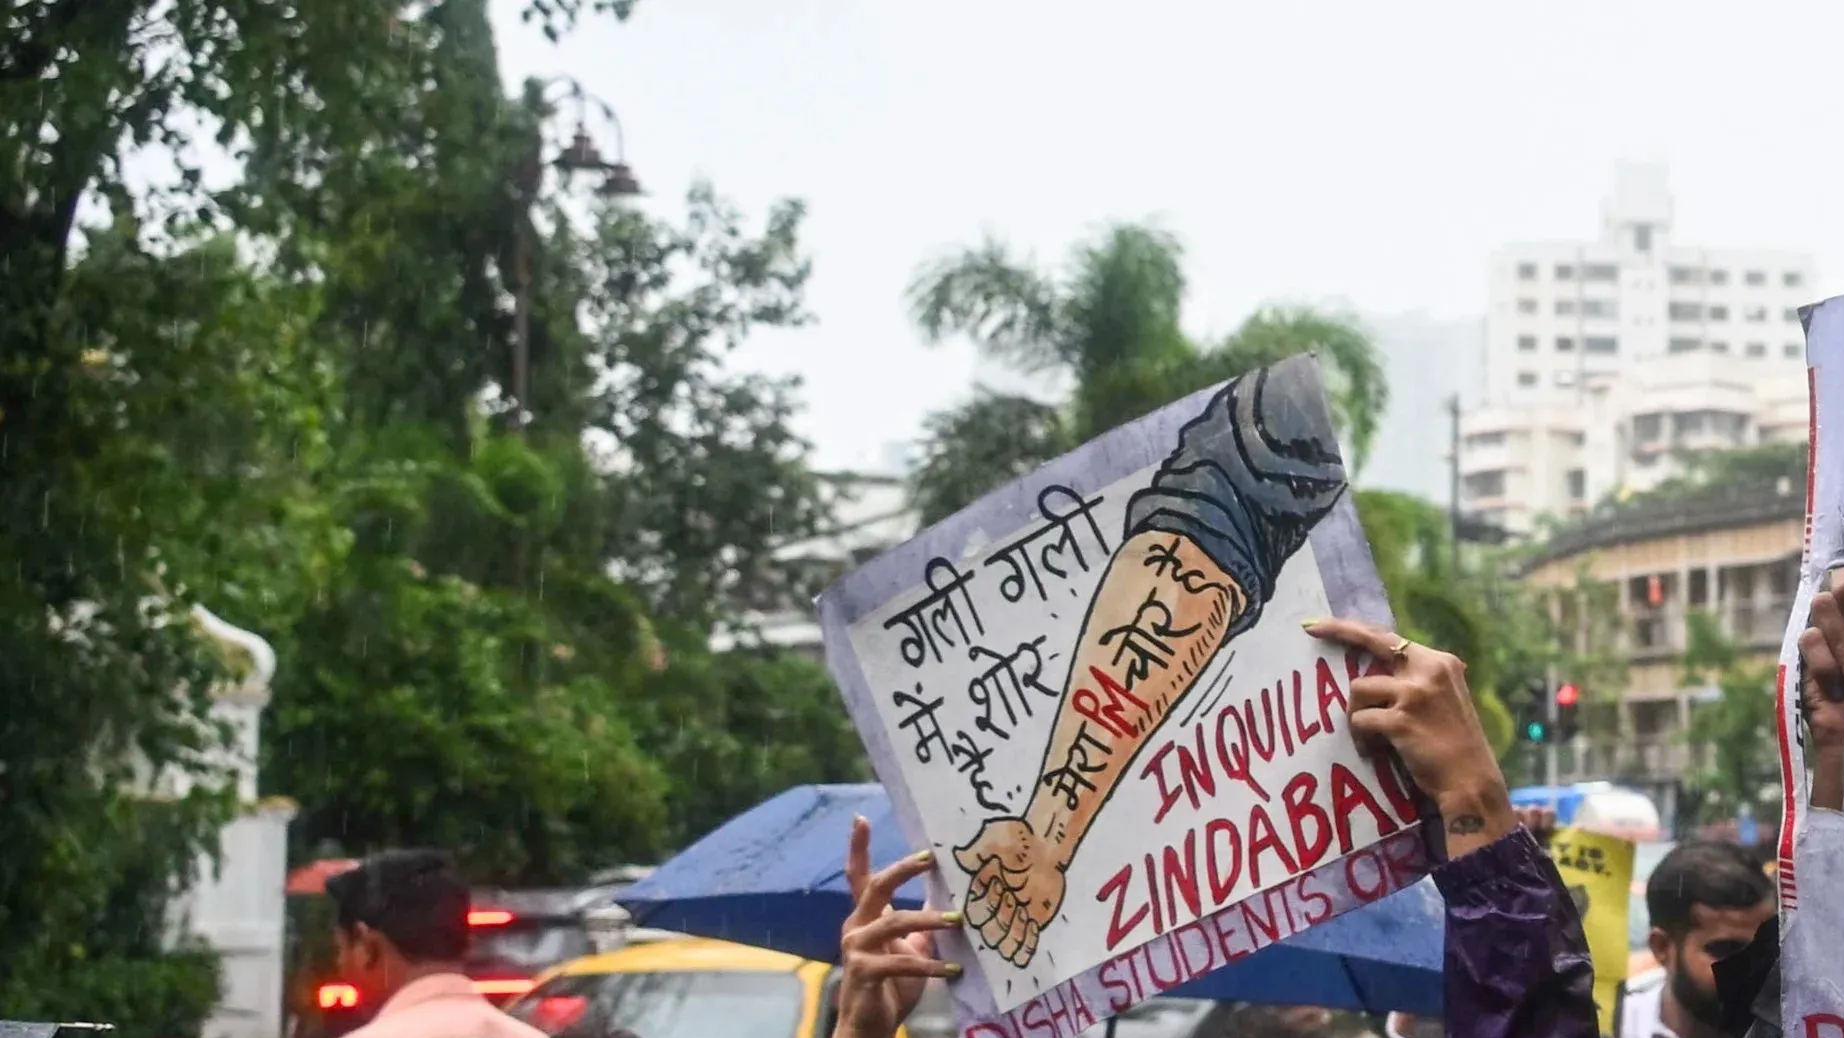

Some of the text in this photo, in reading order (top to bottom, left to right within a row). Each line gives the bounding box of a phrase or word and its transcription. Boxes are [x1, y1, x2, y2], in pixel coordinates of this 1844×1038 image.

[884, 484, 1110, 668] गली गली
[893, 635, 1060, 765] में शोर
[1043, 537, 1228, 811] मेरा PM चोर है
[1099, 872, 1332, 1014] STUDENTS
